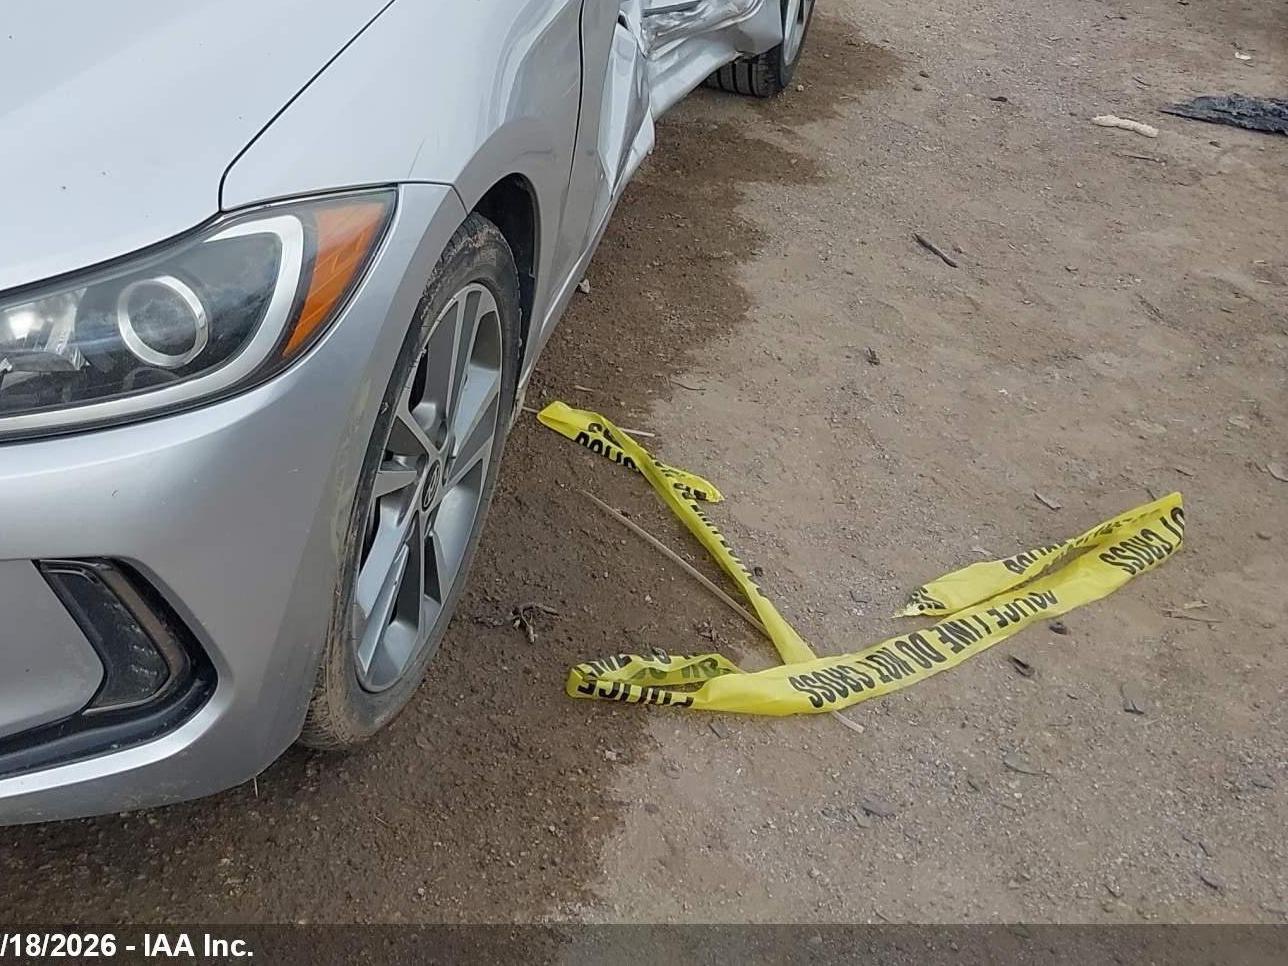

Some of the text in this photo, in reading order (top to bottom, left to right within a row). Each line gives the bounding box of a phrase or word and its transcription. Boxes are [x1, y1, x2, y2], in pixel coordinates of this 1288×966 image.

[1098, 528, 1174, 576] CROSS
[895, 632, 948, 670] DO
[930, 614, 992, 655] LINE
[857, 646, 914, 685] NOT
[787, 664, 876, 709] CROSS
